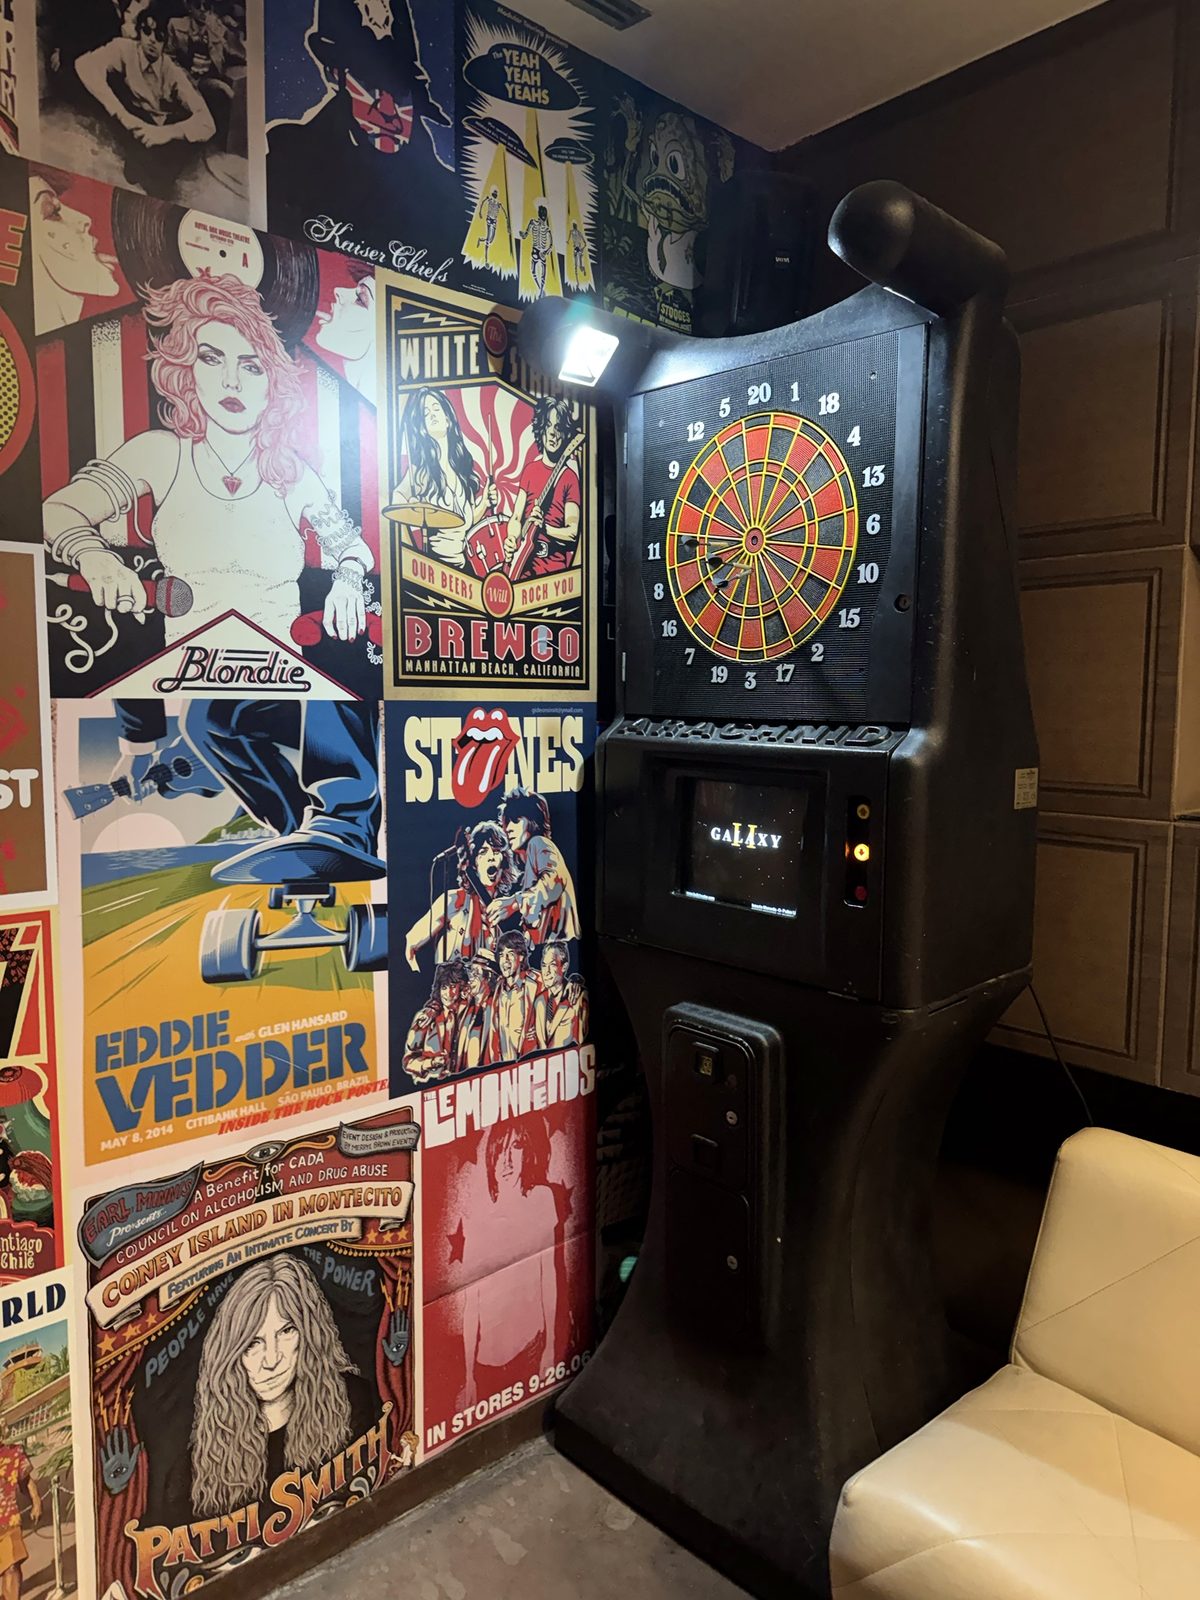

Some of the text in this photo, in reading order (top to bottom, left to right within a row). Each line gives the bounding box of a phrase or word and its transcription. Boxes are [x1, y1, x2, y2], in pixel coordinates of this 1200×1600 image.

[503, 48, 540, 69] YEAH
[504, 65, 541, 86] YEAH
[504, 82, 550, 105] YEAHS
[242, 252, 248, 268] A
[303, 214, 453, 284] Kaiser Chiefs
[660, 303, 691, 324] STOOGES
[400, 334, 480, 380] WHITE
[748, 382, 772, 405] 20
[790, 381, 801, 402] 1
[719, 397, 731, 418] 5
[818, 392, 840, 416] 18
[686, 421, 705, 442] 12
[847, 426, 861, 447] 4
[668, 460, 680, 479] 9
[862, 465, 886, 488] 13
[649, 500, 665, 519] 14
[866, 513, 881, 535] 6
[647, 542, 661, 561] 11
[411, 558, 473, 600] OUR BEERS
[857, 562, 879, 584] 10
[486, 586, 508, 604] Will
[521, 576, 574, 606] ROCK YOU
[653, 582, 664, 599] 8
[661, 619, 677, 637] 16
[838, 608, 861, 629] 15
[404, 615, 580, 664] BREWCO
[685, 647, 696, 665] 7
[811, 643, 824, 662] 2
[153, 645, 312, 693] Blondie
[405, 659, 476, 674] MANHATTAN
[523, 663, 580, 678] CALIFORNIA
[710, 665, 728, 683] 19
[775, 664, 795, 682] 17
[744, 671, 756, 690] 3
[403, 715, 585, 804] STNES
[710, 826, 782, 849] GALAXY
[95, 1010, 230, 1073] EDDIE
[258, 1021, 291, 1038] GLEN
[292, 1010, 348, 1032] HANSARD
[95, 1022, 369, 1133] VEDDER
[100, 1136, 128, 1152] MAY
[131, 1130, 144, 1144] 8,
[146, 1123, 174, 1141] 2014
[186, 1108, 239, 1131] CITIBANK
[239, 1101, 268, 1118] HALL
[277, 1091, 300, 1106] SÃO
[336, 1075, 369, 1092] BRAZIL
[217, 1079, 389, 1135] INSIDE THE ROCK POSTE
[342, 1127, 418, 1142] EVENT DESIGN & PRODUCTION
[373, 1140, 391, 1148] BROWN
[391, 1137, 416, 1146] EVENTS
[194, 1152, 325, 1204] A Benefit for CADA
[84, 1197, 131, 1245] EARL
[116, 1164, 388, 1264] COUNCIL ON ALCOHOLISM AND DRUG ABUSE
[0, 1231, 43, 1257] ntiago
[102, 1186, 403, 1309] CONEY ISLAND IN MONTECITO
[1, 1251, 35, 1270] Chile
[167, 1259, 224, 1300] FEATURING
[245, 1231, 293, 1257] INTIMATE
[295, 1221, 339, 1241] CONCERT
[303, 1246, 376, 1297] THE POWER
[145, 1272, 234, 1388] PEOPLE HAVE
[427, 1350, 591, 1448] IN STORES 9.26.06
[124, 1401, 393, 1600] PATTI SMITH
